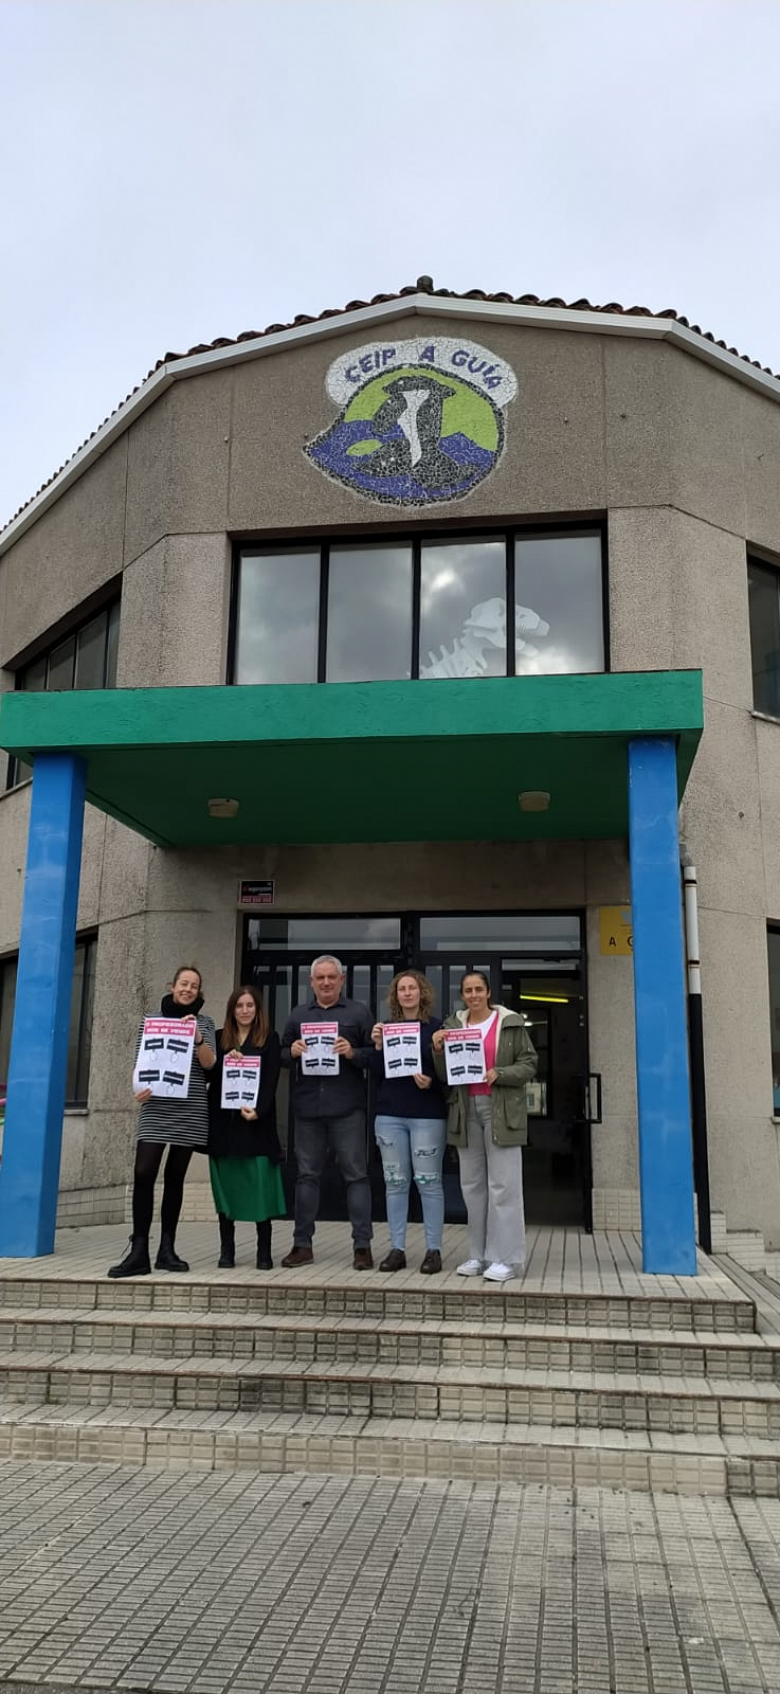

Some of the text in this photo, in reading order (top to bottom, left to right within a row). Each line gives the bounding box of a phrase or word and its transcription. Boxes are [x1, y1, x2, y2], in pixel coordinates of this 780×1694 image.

[345, 349, 396, 383] CEIP
[418, 345, 436, 363] A
[609, 936, 617, 947] A
